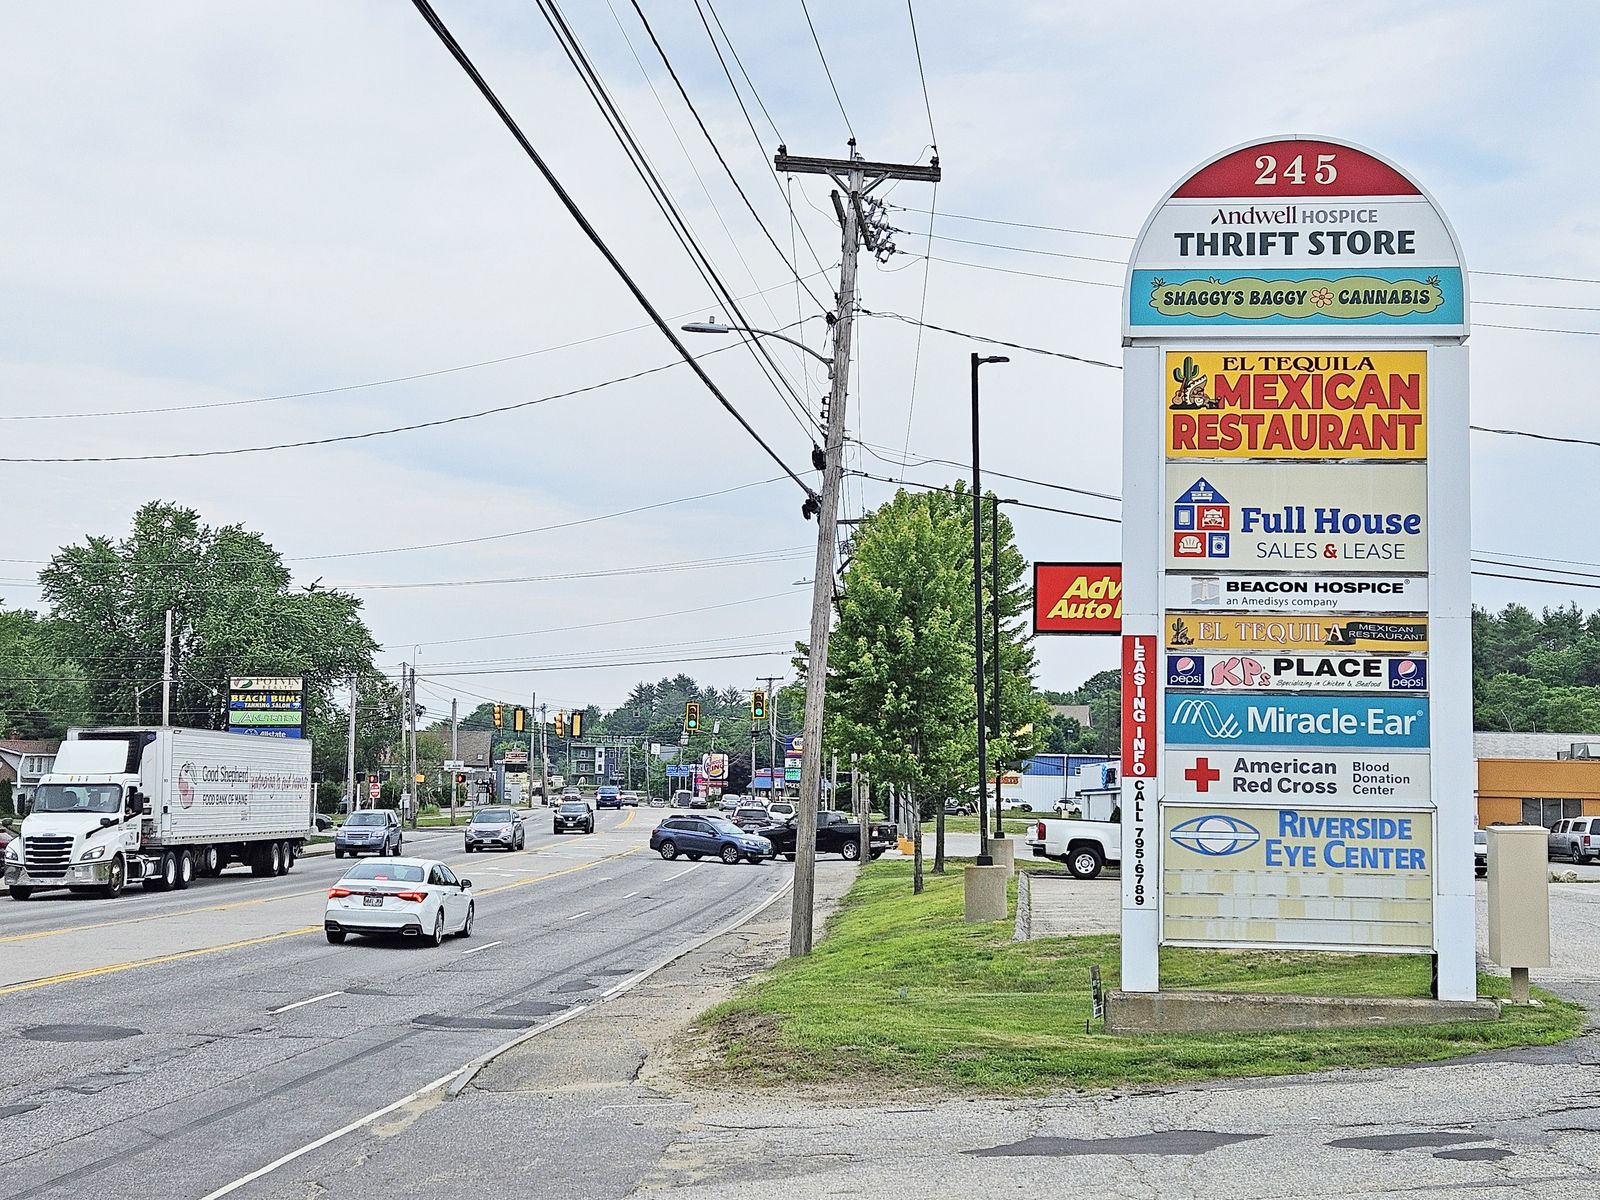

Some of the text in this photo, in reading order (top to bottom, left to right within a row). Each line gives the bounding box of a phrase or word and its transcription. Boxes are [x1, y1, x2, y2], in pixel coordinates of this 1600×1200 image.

[1254, 154, 1337, 185] 245
[1211, 206, 1378, 225] Andwell HOSPICE
[1174, 230, 1415, 256] THRIFT STORE
[1163, 289, 1431, 306] SHAGGY'S BAGGY CANNABIS
[1223, 356, 1375, 372] EL TEQUILA
[1214, 373, 1420, 410] MEXICAN
[1172, 413, 1422, 451] RESTAURANT
[1241, 506, 1421, 535] Full House
[1256, 542, 1406, 559] SALES & LEASE
[1226, 581, 1307, 593] BEACON
[1046, 600, 1112, 619] Auto
[1241, 596, 1289, 607] Amedisys
[1291, 598, 1338, 608] company
[1199, 622, 1343, 644] EL TEQUILA
[1348, 631, 1425, 641] RESTAURANT
[1358, 623, 1414, 633] MEXICAN
[1273, 658, 1382, 677] PLACE
[1170, 674, 1202, 685] pepsi
[1276, 680, 1312, 688] Specializing
[1391, 677, 1424, 689] pepsi
[1133, 637, 1147, 776] LEASING INFO
[1233, 758, 1337, 774] American
[1352, 762, 1389, 772] Blood
[202, 765, 219, 782] Good
[220, 766, 249, 787] Shepherd
[1352, 774, 1410, 784] Donation
[1233, 778, 1338, 794] Red Cross
[1352, 785, 1394, 795] Center
[203, 794, 215, 805] FOOD
[216, 794, 228, 805] BANK
[1134, 779, 1146, 822] CALL
[1279, 810, 1412, 840] RIVERSIDE
[1266, 839, 1426, 870] EYE CENTER
